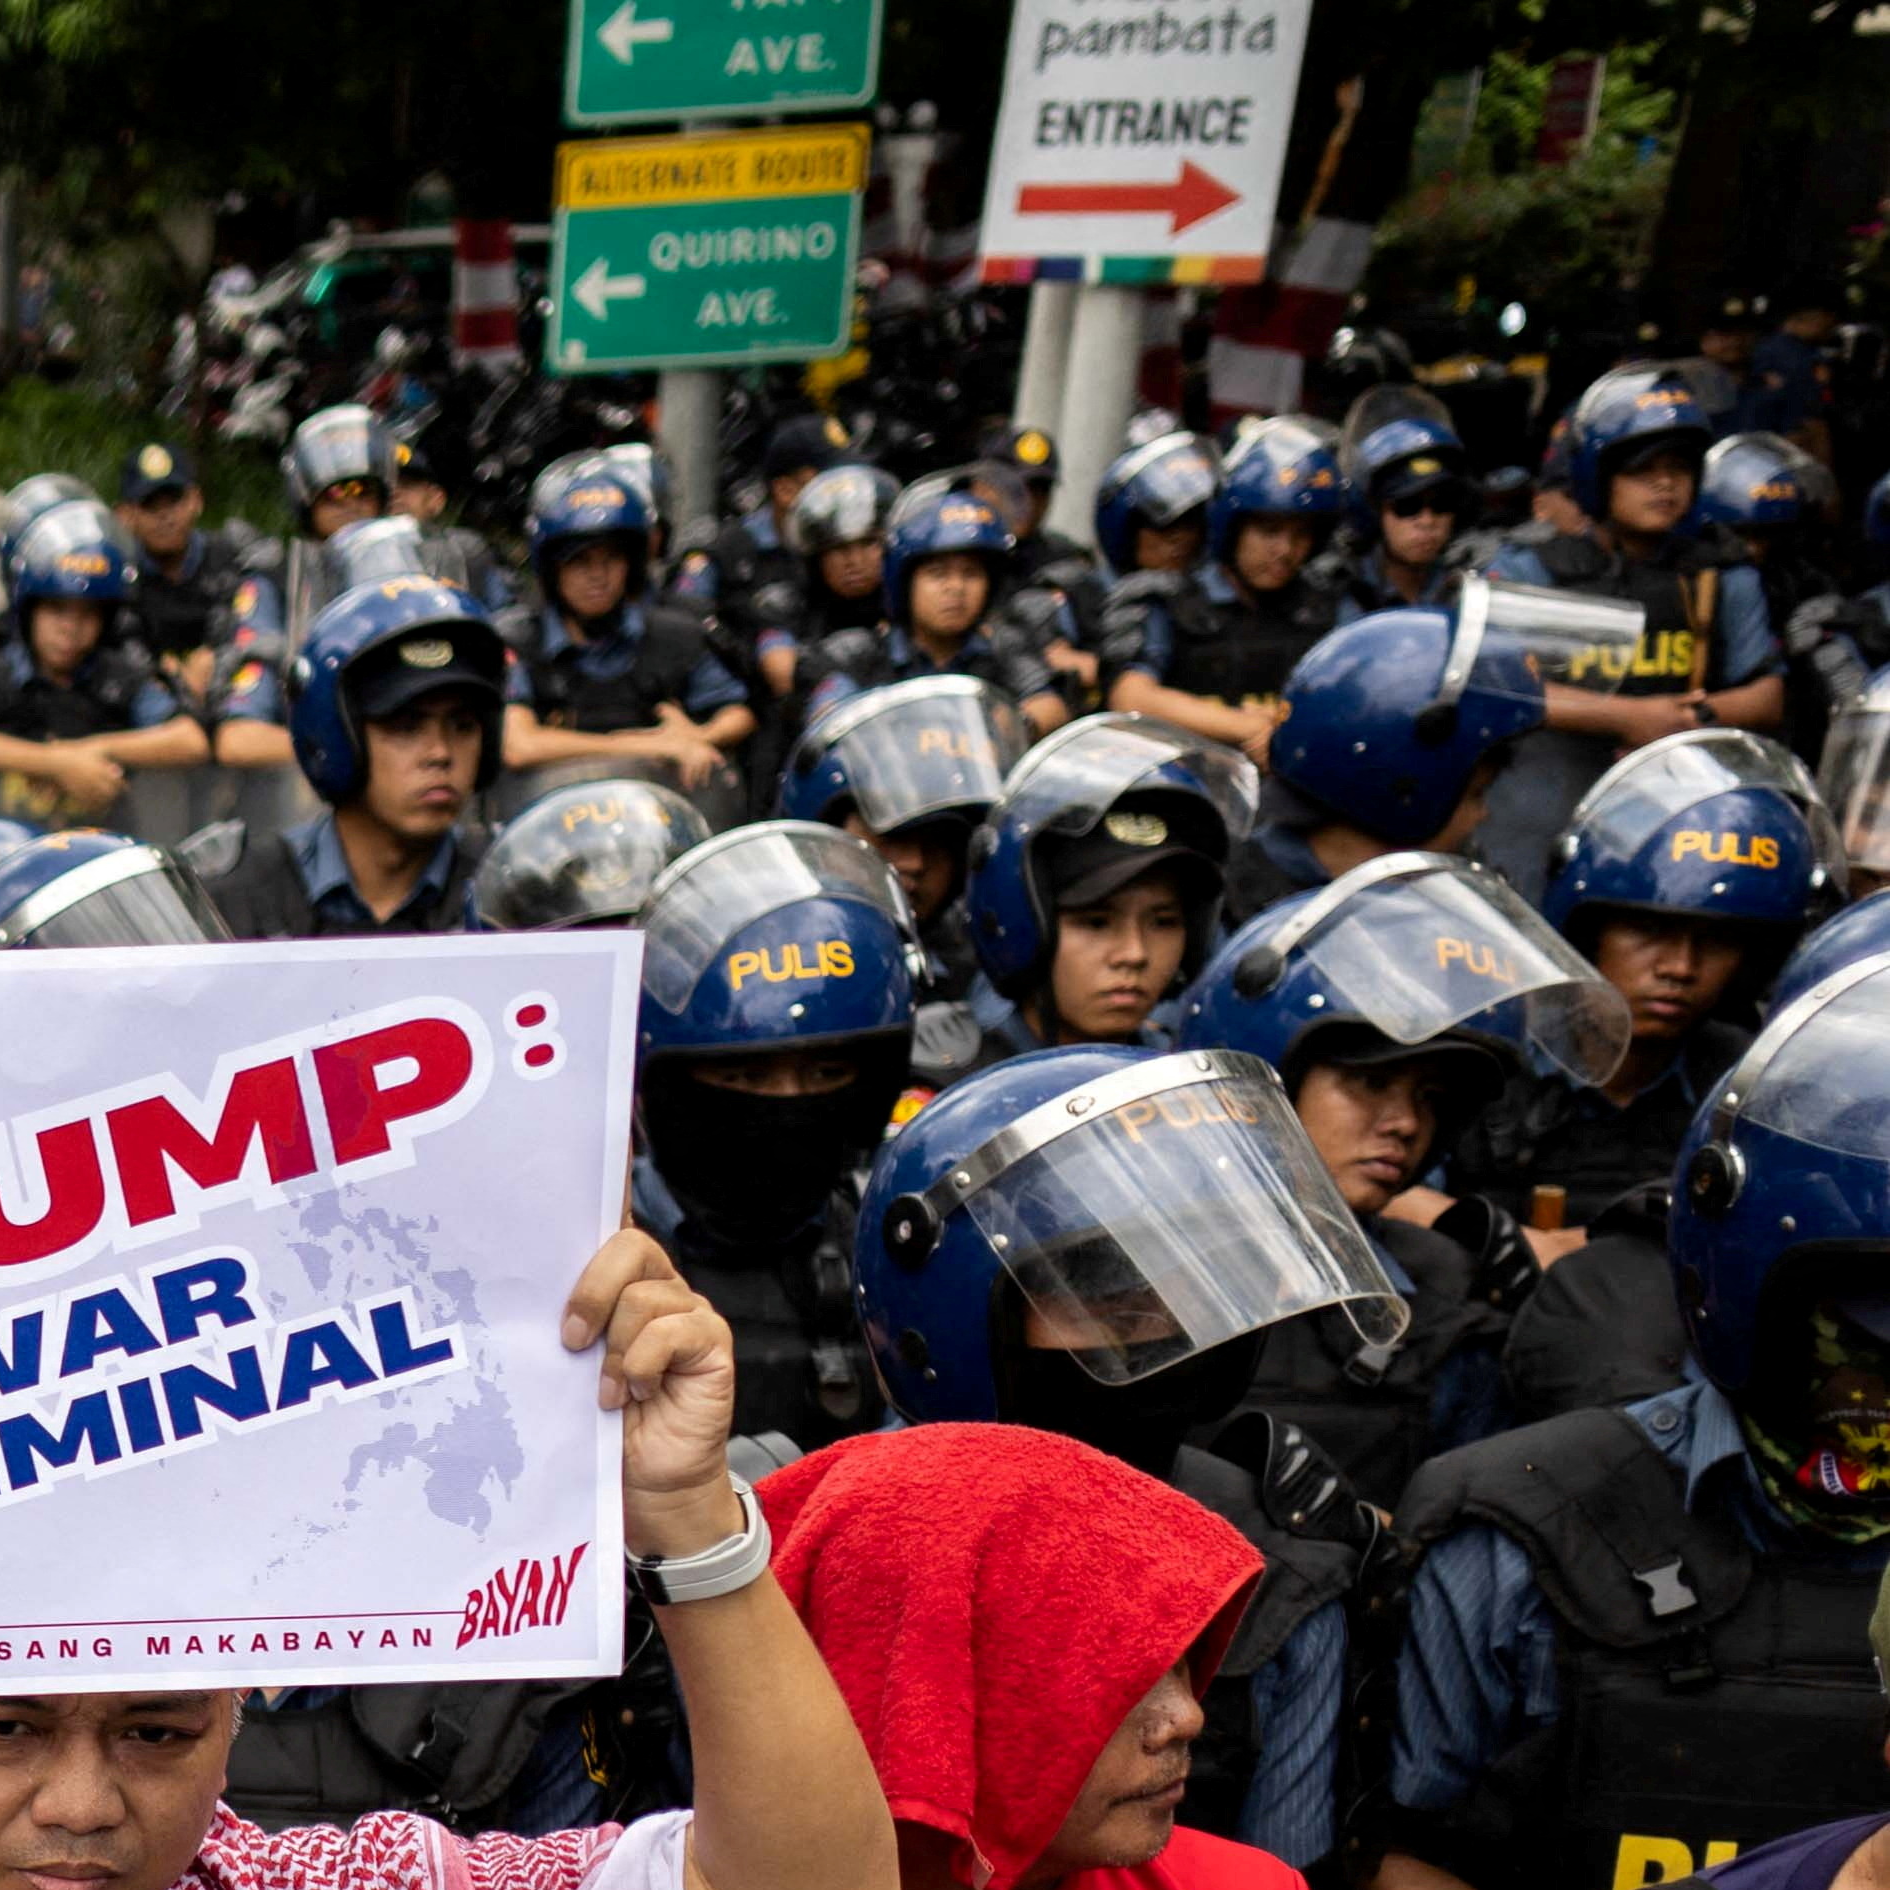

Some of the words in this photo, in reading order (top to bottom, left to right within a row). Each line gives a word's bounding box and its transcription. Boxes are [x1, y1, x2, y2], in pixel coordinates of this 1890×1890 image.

[724, 32, 836, 77] AVE.
[1034, 7, 1276, 75] pambata
[1035, 95, 1252, 147] ENTRANCE
[581, 151, 737, 196] ALTERNATE
[752, 146, 849, 182] ROUTE
[648, 222, 836, 272] QUIRINO
[695, 287, 789, 329] AVE.
[1570, 631, 1695, 682] PULIS
[1669, 830, 1780, 872] PULIS
[728, 940, 856, 991] PULIS
[456, 1541, 590, 1650] BAYAN
[146, 1627, 432, 1656] MAKABAYAN
